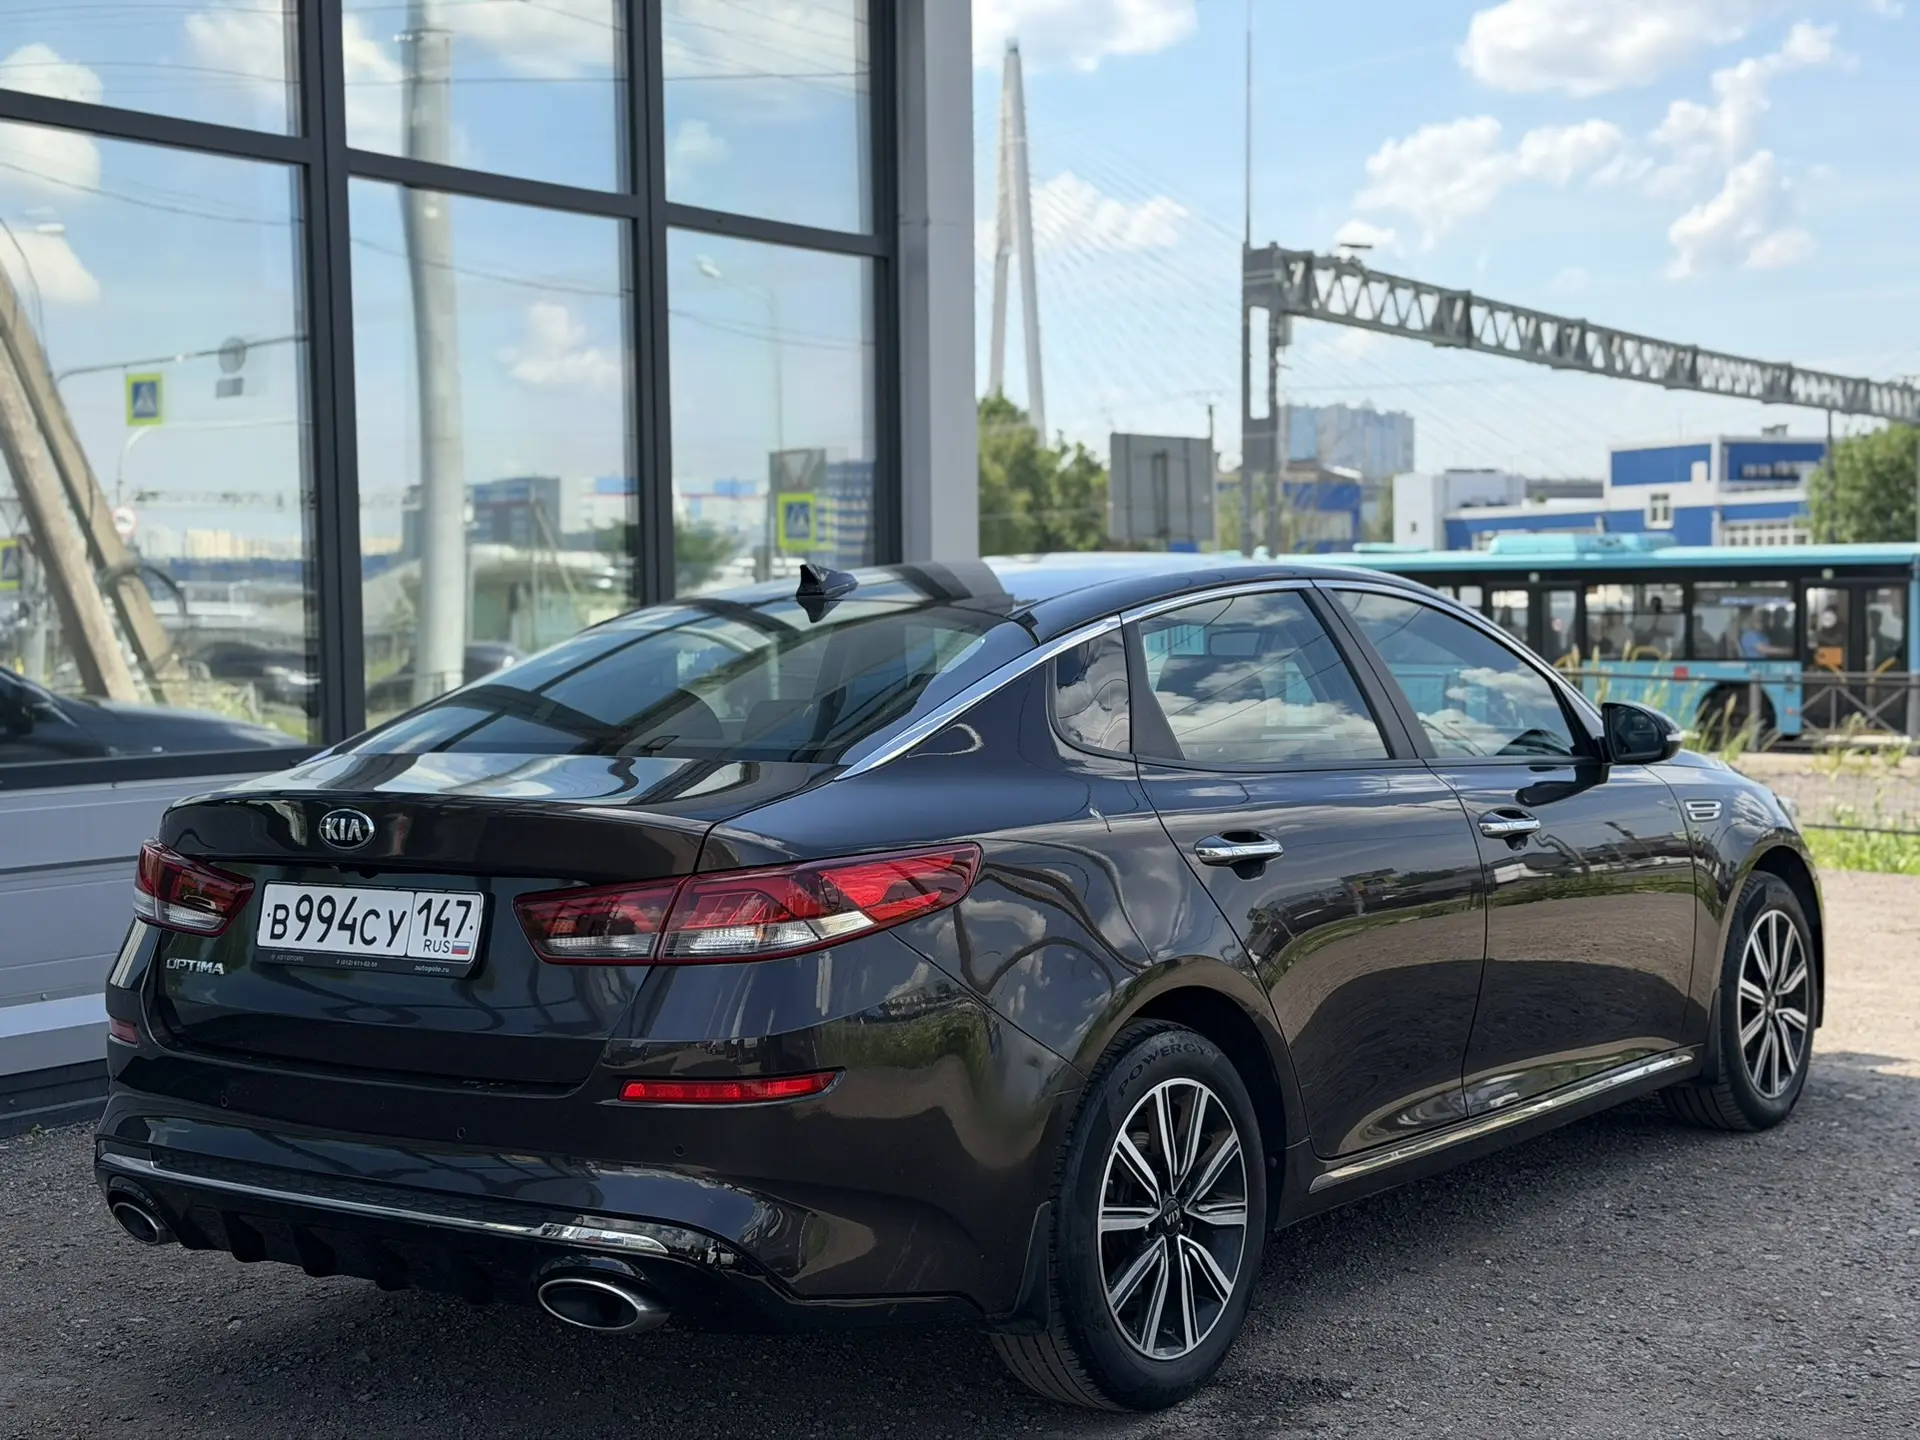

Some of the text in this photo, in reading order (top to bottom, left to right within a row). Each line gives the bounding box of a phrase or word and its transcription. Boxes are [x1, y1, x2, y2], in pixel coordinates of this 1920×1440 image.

[325, 817, 364, 842] KIA
[269, 893, 472, 948] В994СУ 147
[423, 939, 451, 954] RUS
[166, 958, 225, 975] OPTIMA
